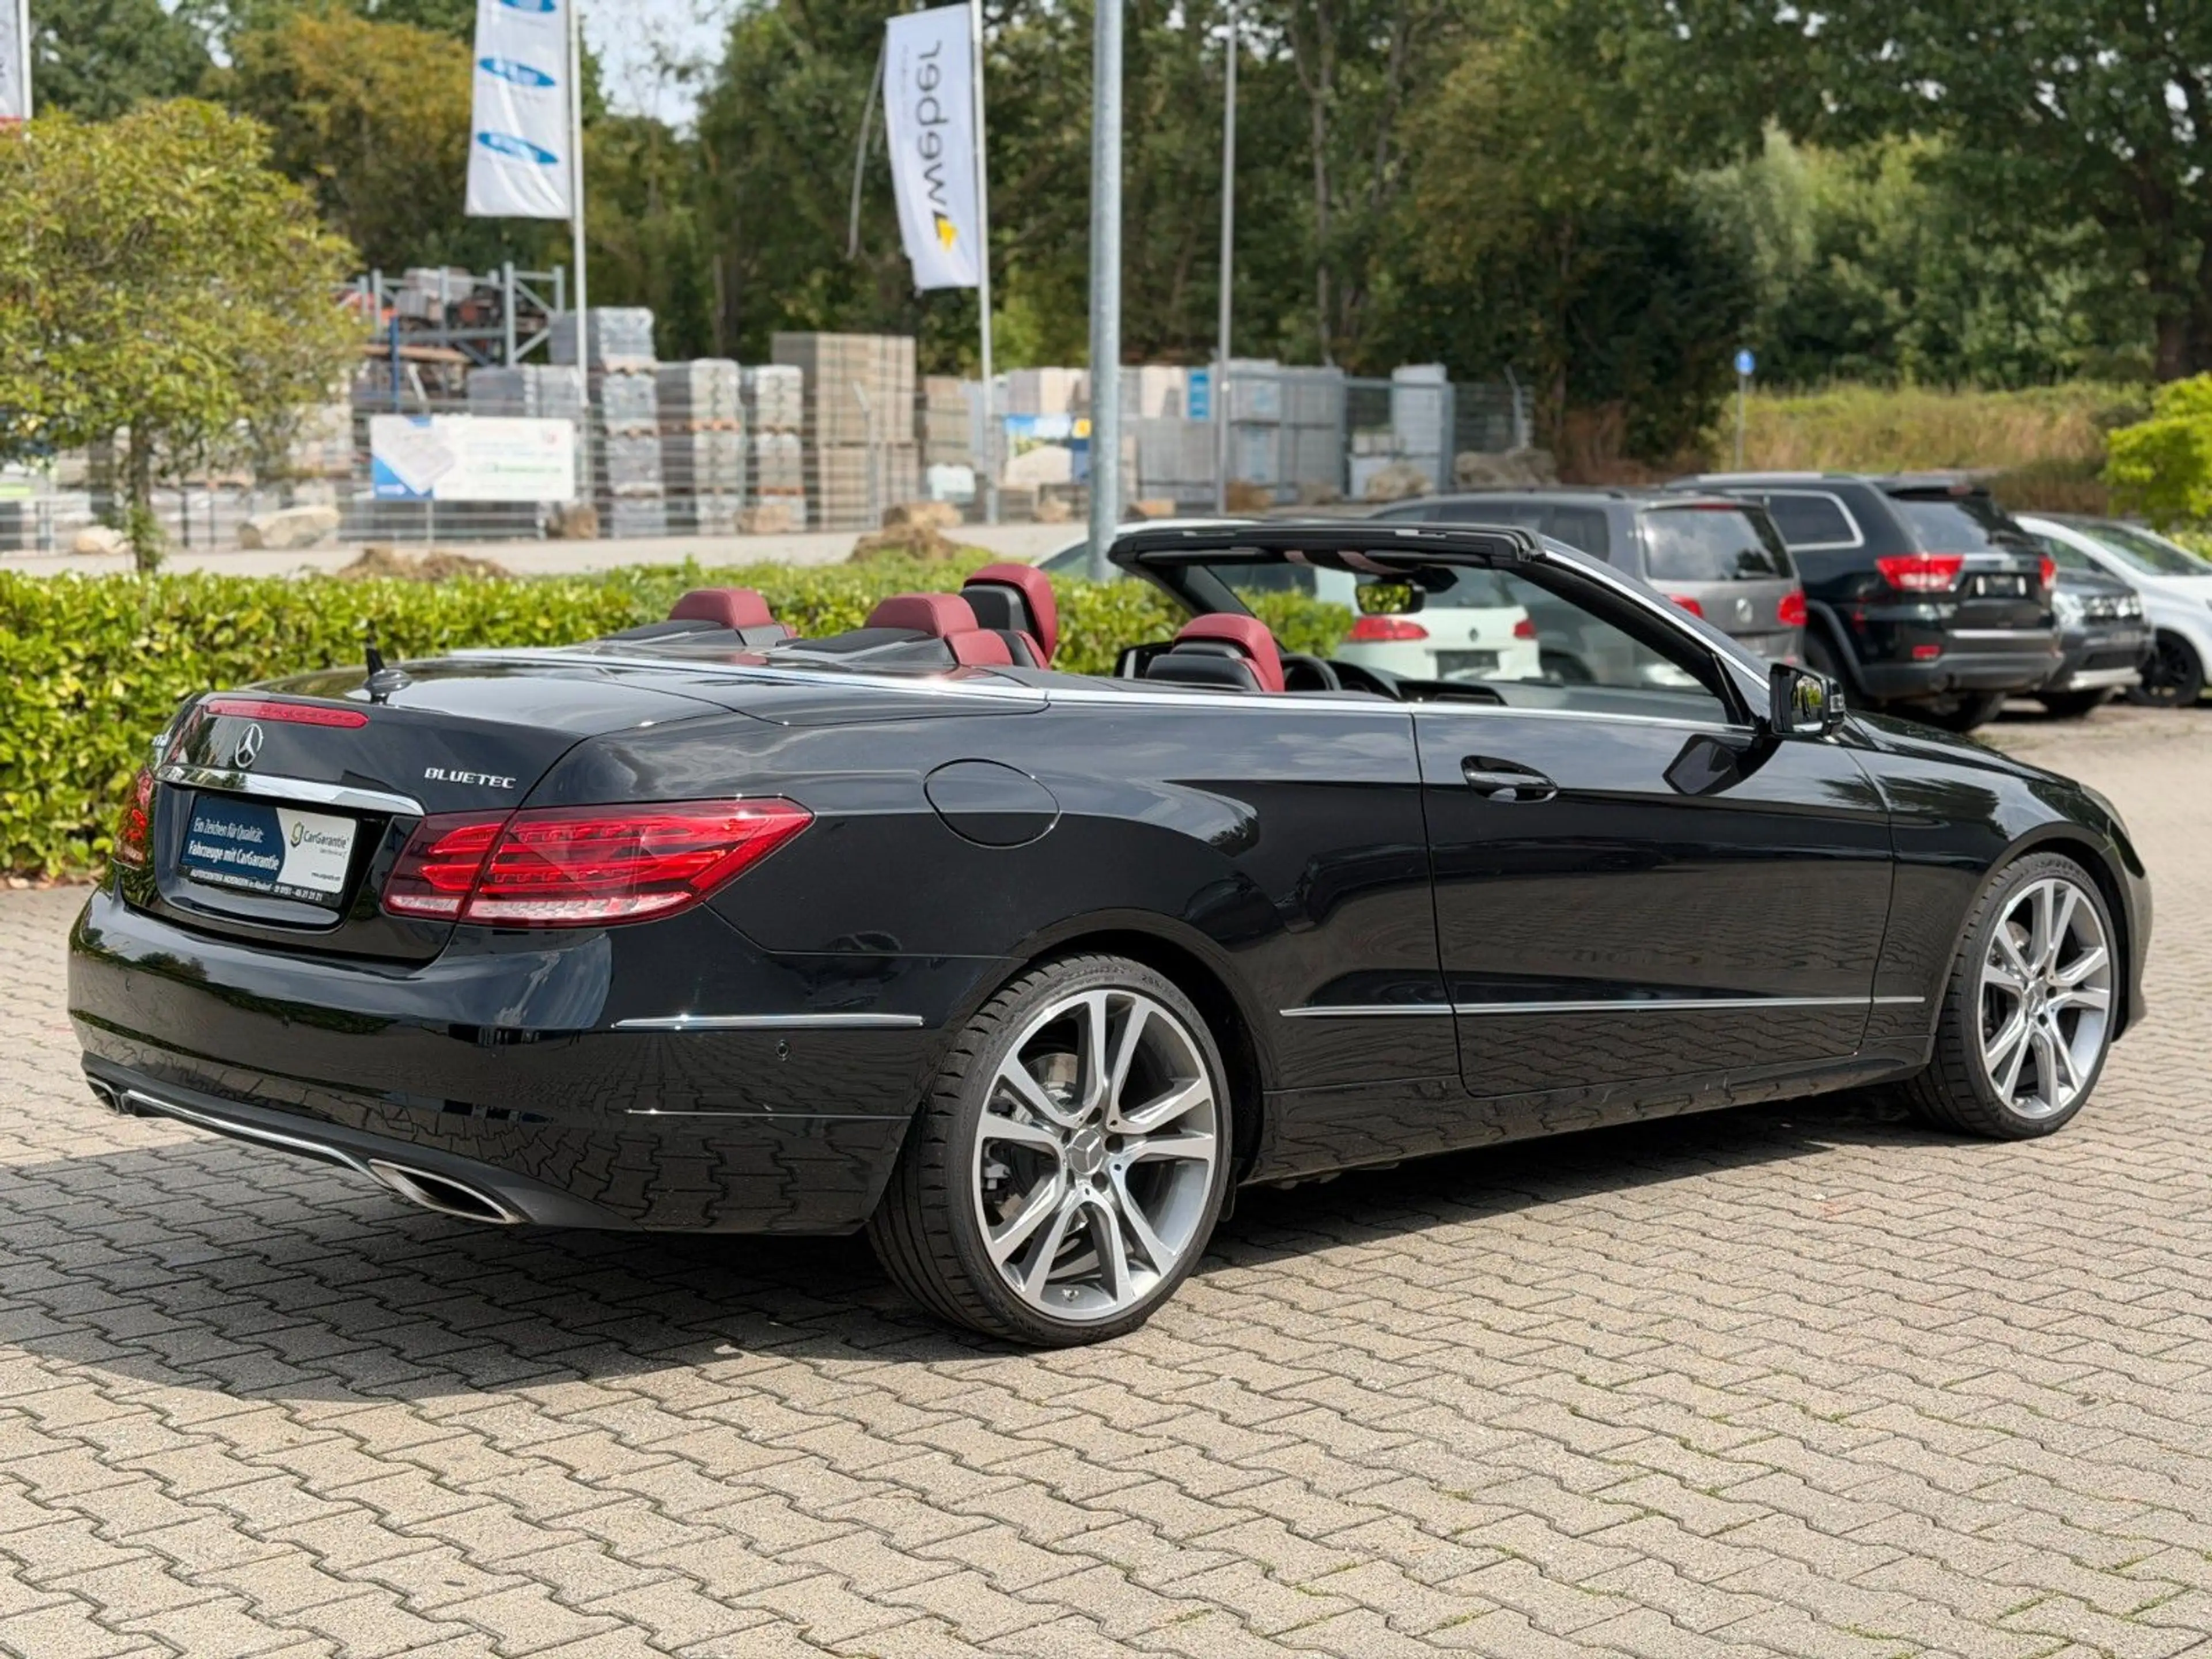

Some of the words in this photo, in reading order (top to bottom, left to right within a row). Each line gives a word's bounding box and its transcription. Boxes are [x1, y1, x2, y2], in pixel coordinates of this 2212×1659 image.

[424, 767, 517, 789] BLUETEC
[193, 817, 204, 833] Ein
[204, 819, 227, 836] Zeichen
[188, 840, 224, 863] Fahrzeuge
[223, 847, 237, 862] mit
[237, 849, 279, 870] CarGarantie
